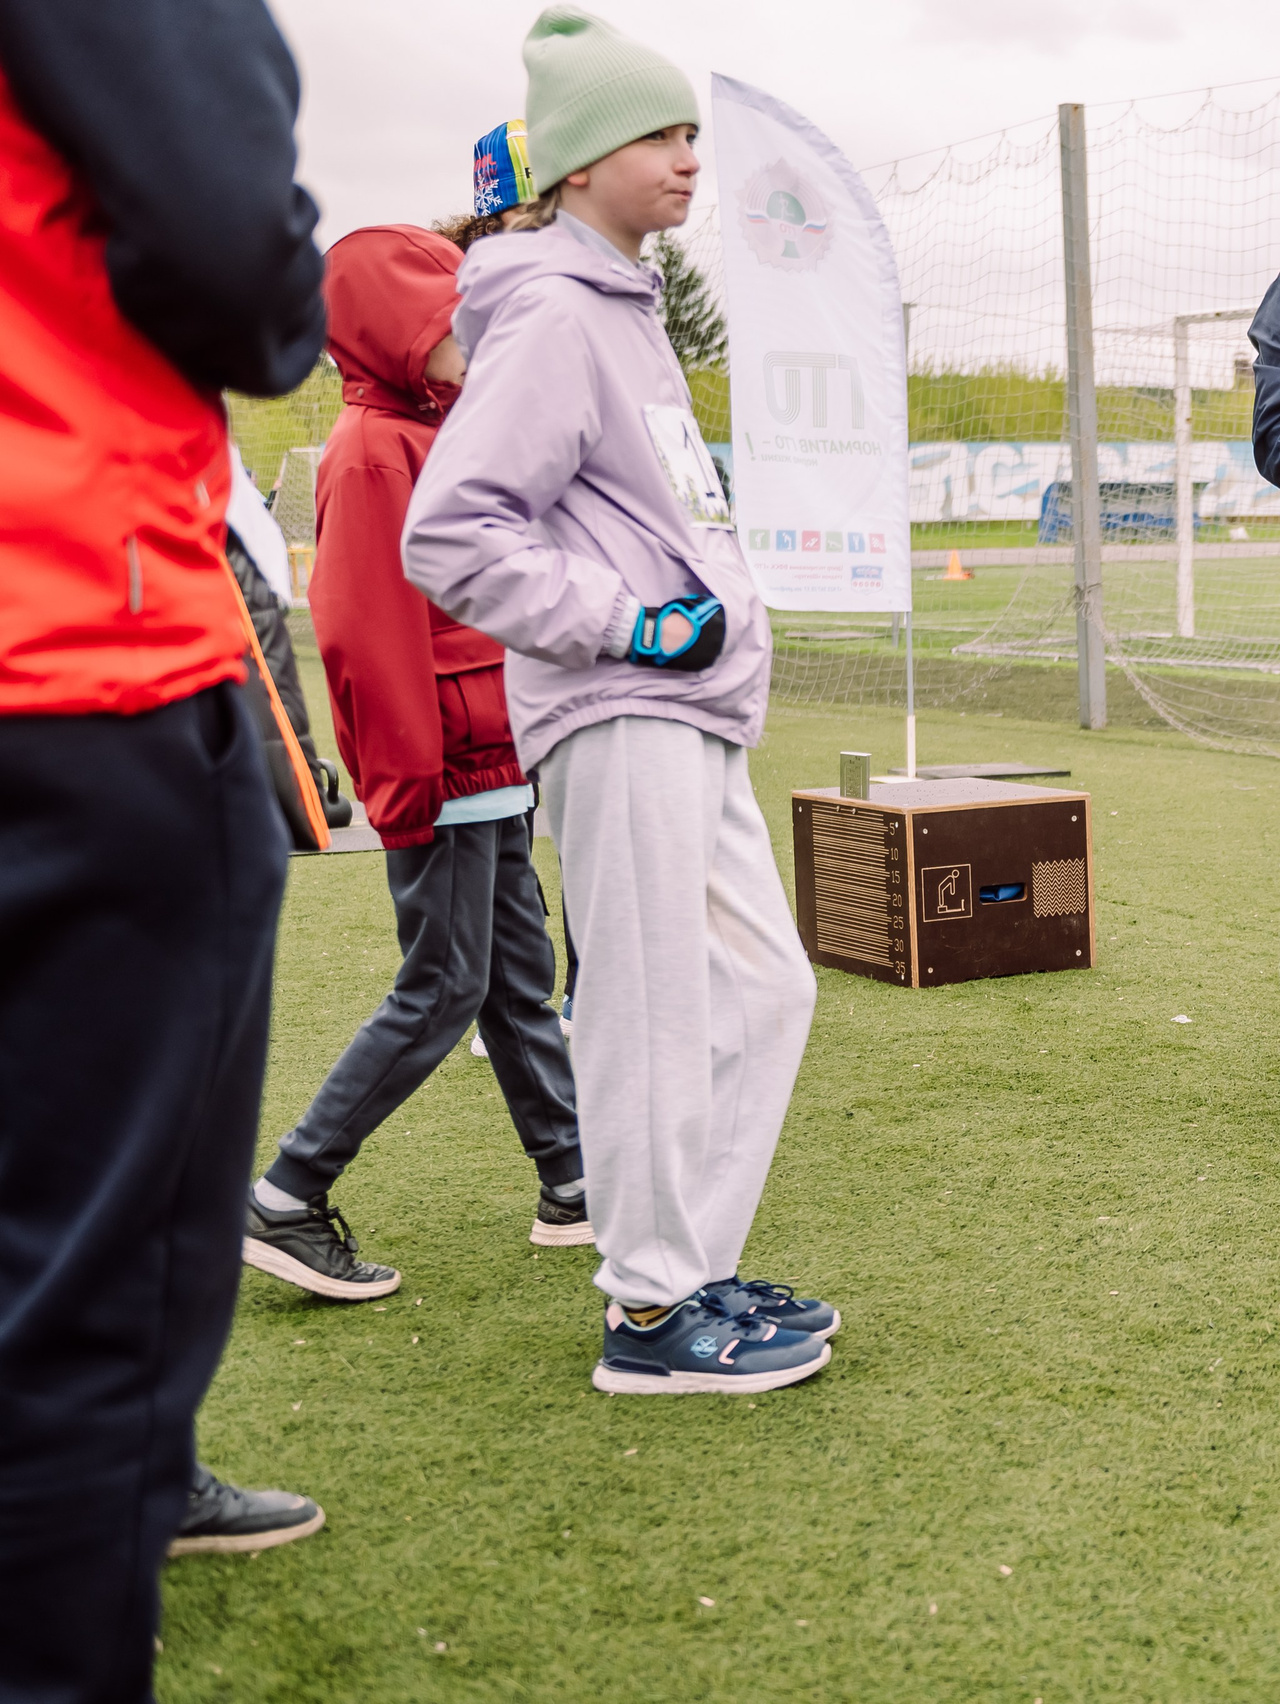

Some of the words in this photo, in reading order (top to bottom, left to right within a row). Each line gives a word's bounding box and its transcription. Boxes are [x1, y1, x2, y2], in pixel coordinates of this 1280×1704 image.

[890, 822, 895, 836] 5
[890, 847, 899, 861] 10
[891, 870, 900, 884] 15
[892, 893, 902, 907] 20
[893, 915, 904, 930] 25
[894, 938, 904, 952] 30
[895, 961, 906, 975] 35
